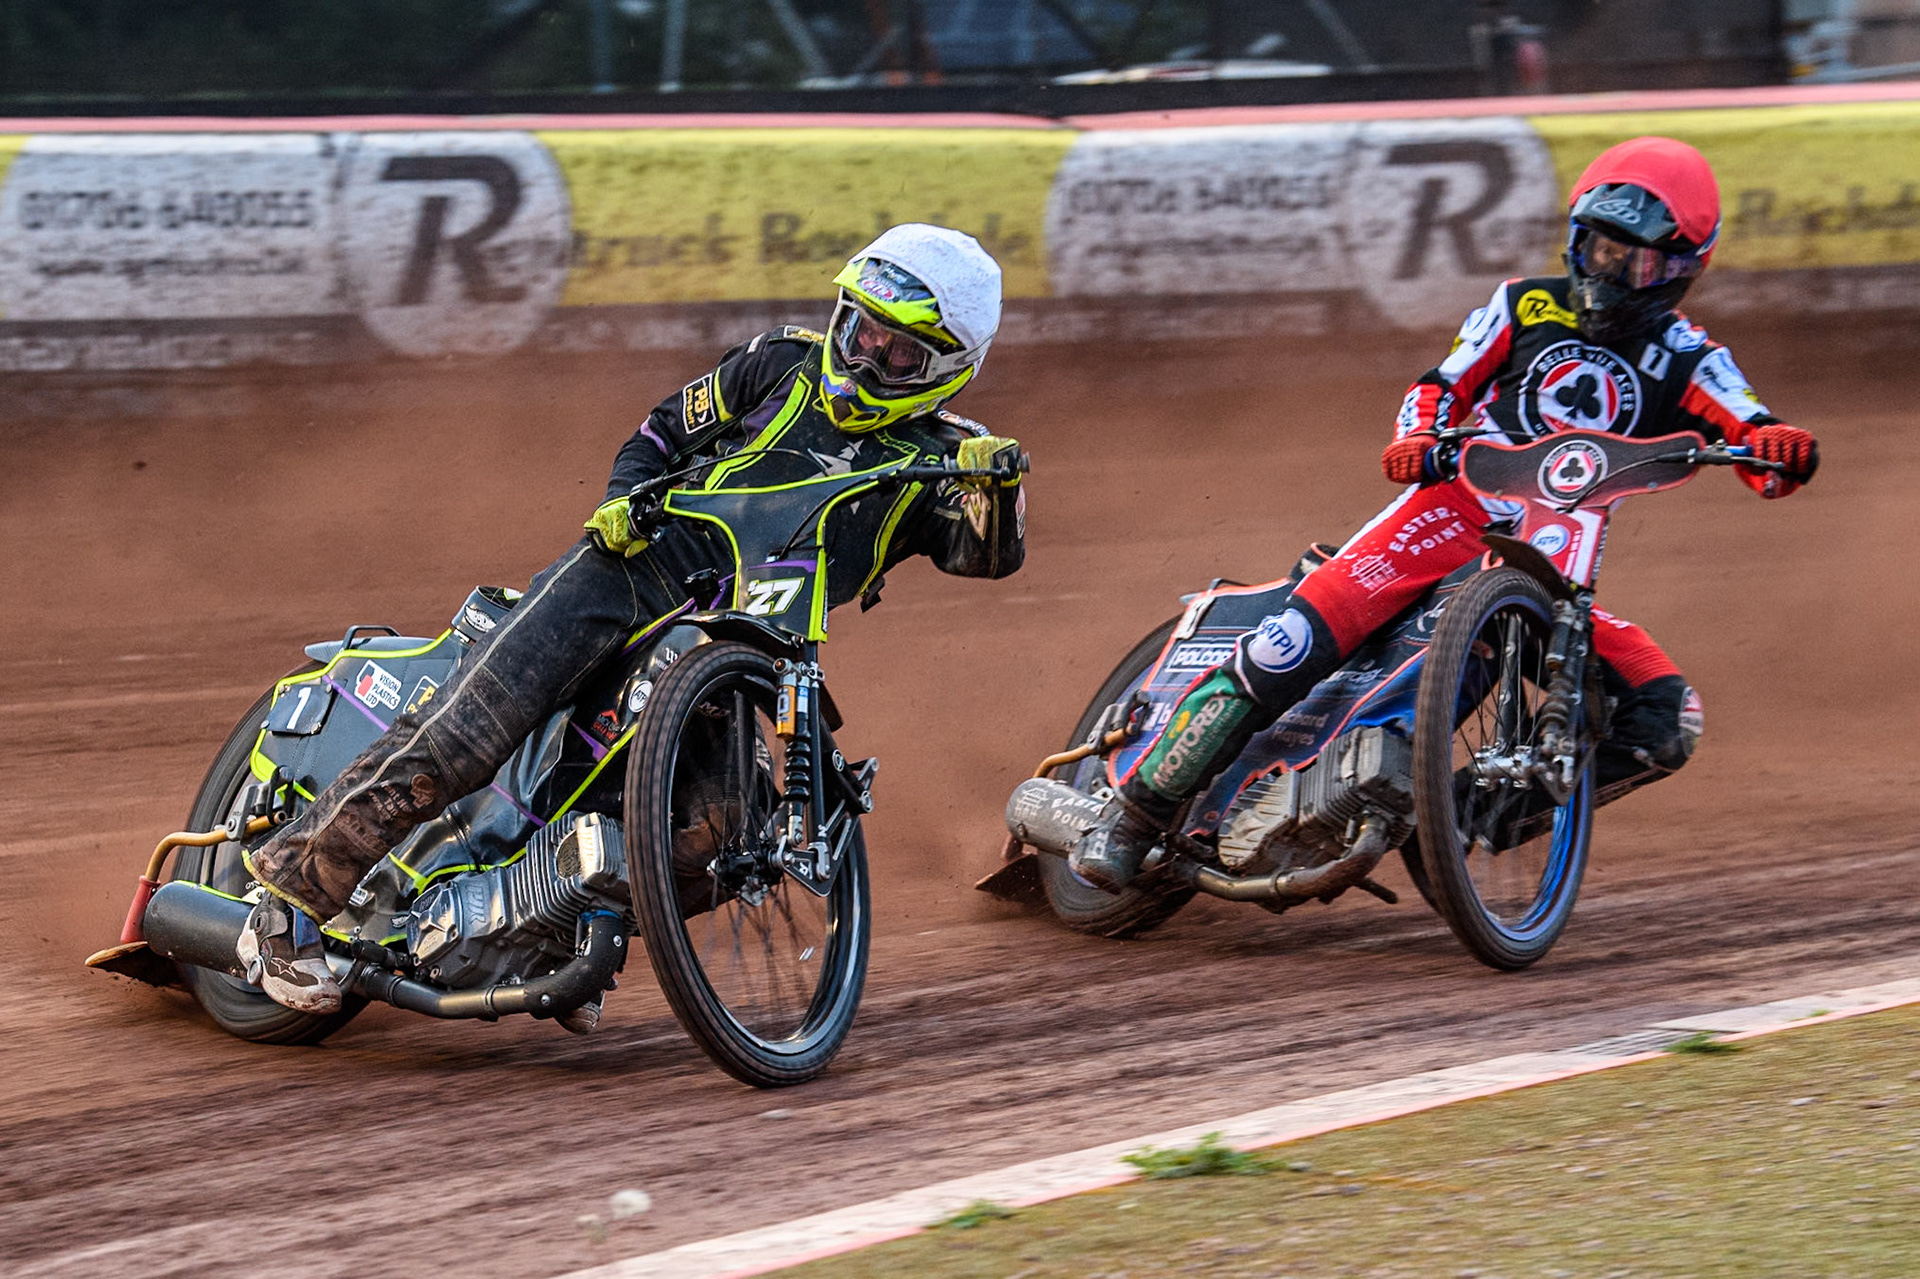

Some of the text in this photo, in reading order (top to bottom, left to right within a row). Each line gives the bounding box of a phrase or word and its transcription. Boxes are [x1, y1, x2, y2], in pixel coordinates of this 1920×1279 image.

[1536, 346, 1636, 412] BELLE VUE ACES
[694, 386, 711, 414] PB
[1408, 520, 1466, 556] POINT
[1262, 621, 1296, 657] ATPI
[371, 683, 399, 707] PLASTICS
[379, 673, 400, 692] VISION
[286, 687, 312, 730] 1
[365, 693, 379, 705] LTD
[1051, 797, 1104, 816] EASTE
[1053, 810, 1095, 830] POIN
